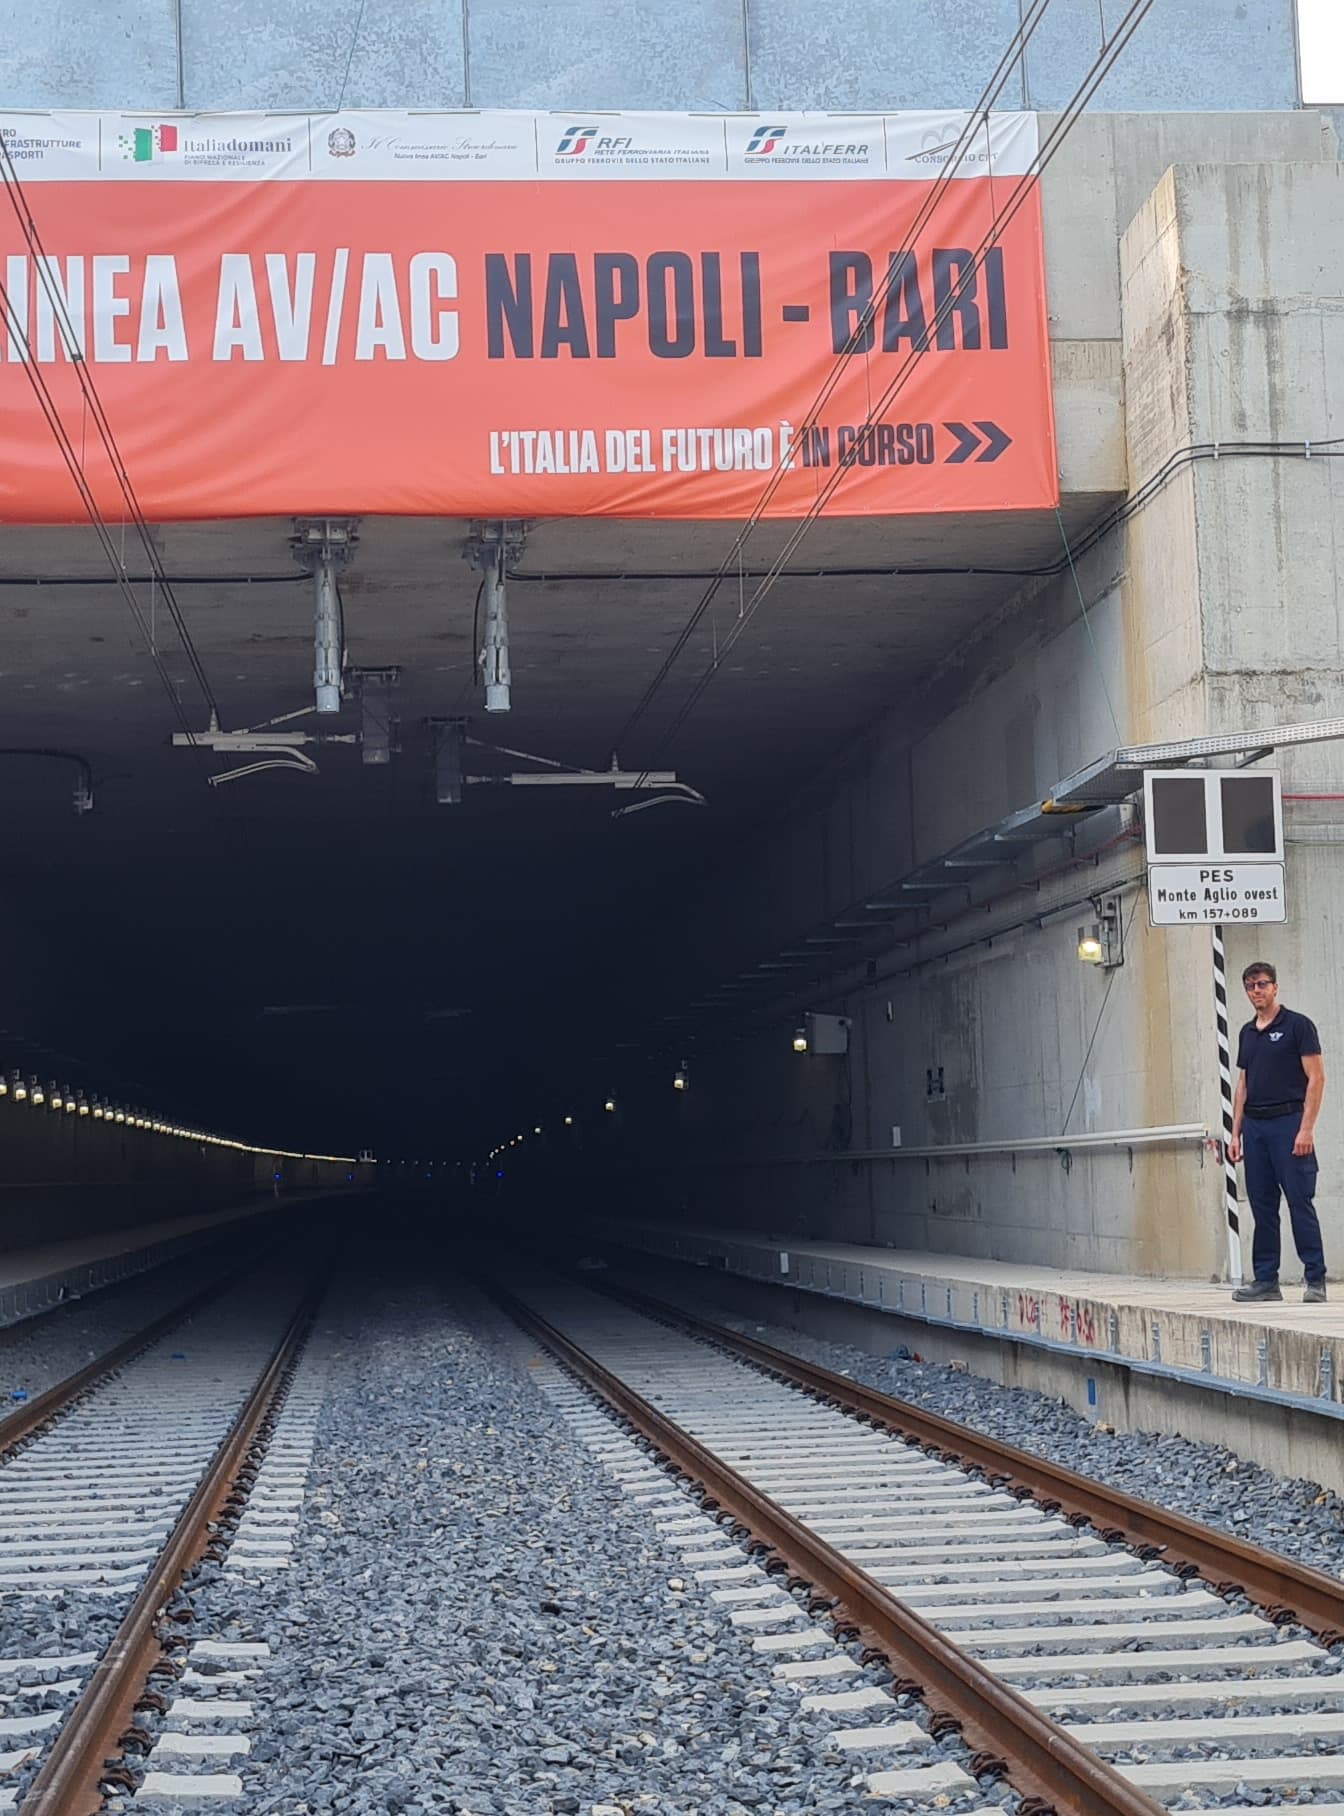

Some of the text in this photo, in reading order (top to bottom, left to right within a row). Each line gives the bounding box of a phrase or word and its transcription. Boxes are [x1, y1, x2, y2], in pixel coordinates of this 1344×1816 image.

[184, 138, 292, 152] Italiadomani
[597, 138, 632, 148] RFI
[784, 144, 869, 155] ITALFERR
[213, 247, 460, 365] AV/AC
[486, 250, 763, 359] NAPOLI
[783, 305, 810, 322] -
[829, 246, 1009, 356] BARI
[490, 419, 936, 474] L'ITALIA DEL FUTURO È IN CORSO
[1200, 869, 1234, 882] PES
[1157, 887, 1279, 903] Monte Aglio ovest
[1179, 907, 1258, 919] km 157+089
